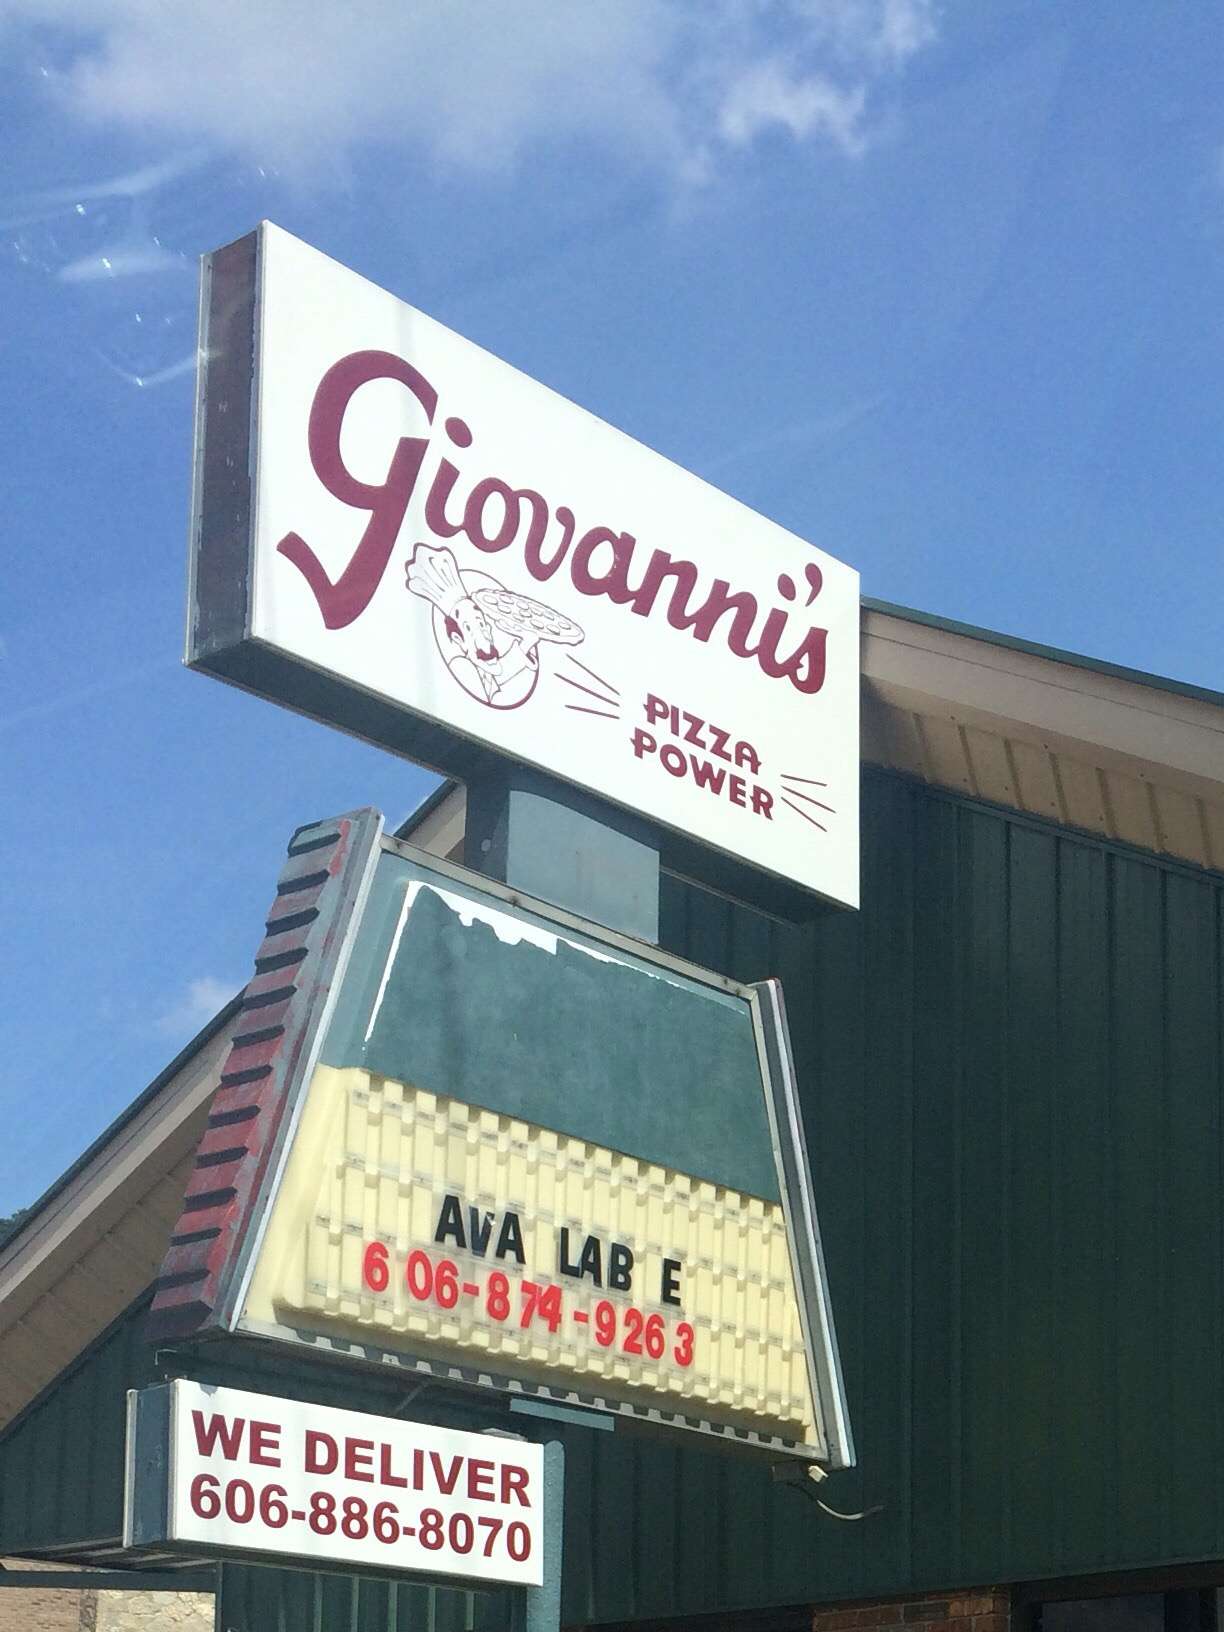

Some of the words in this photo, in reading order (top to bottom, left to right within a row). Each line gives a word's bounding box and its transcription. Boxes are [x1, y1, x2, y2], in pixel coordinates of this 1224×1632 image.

[276, 349, 829, 695] Giovanni's
[629, 727, 774, 820] POWER
[643, 692, 763, 776] PIZZA
[434, 1193, 527, 1265] AVA
[190, 1410, 283, 1468] WE
[304, 1429, 532, 1508] DELIVER
[190, 1473, 533, 1563] 606-886-8070
